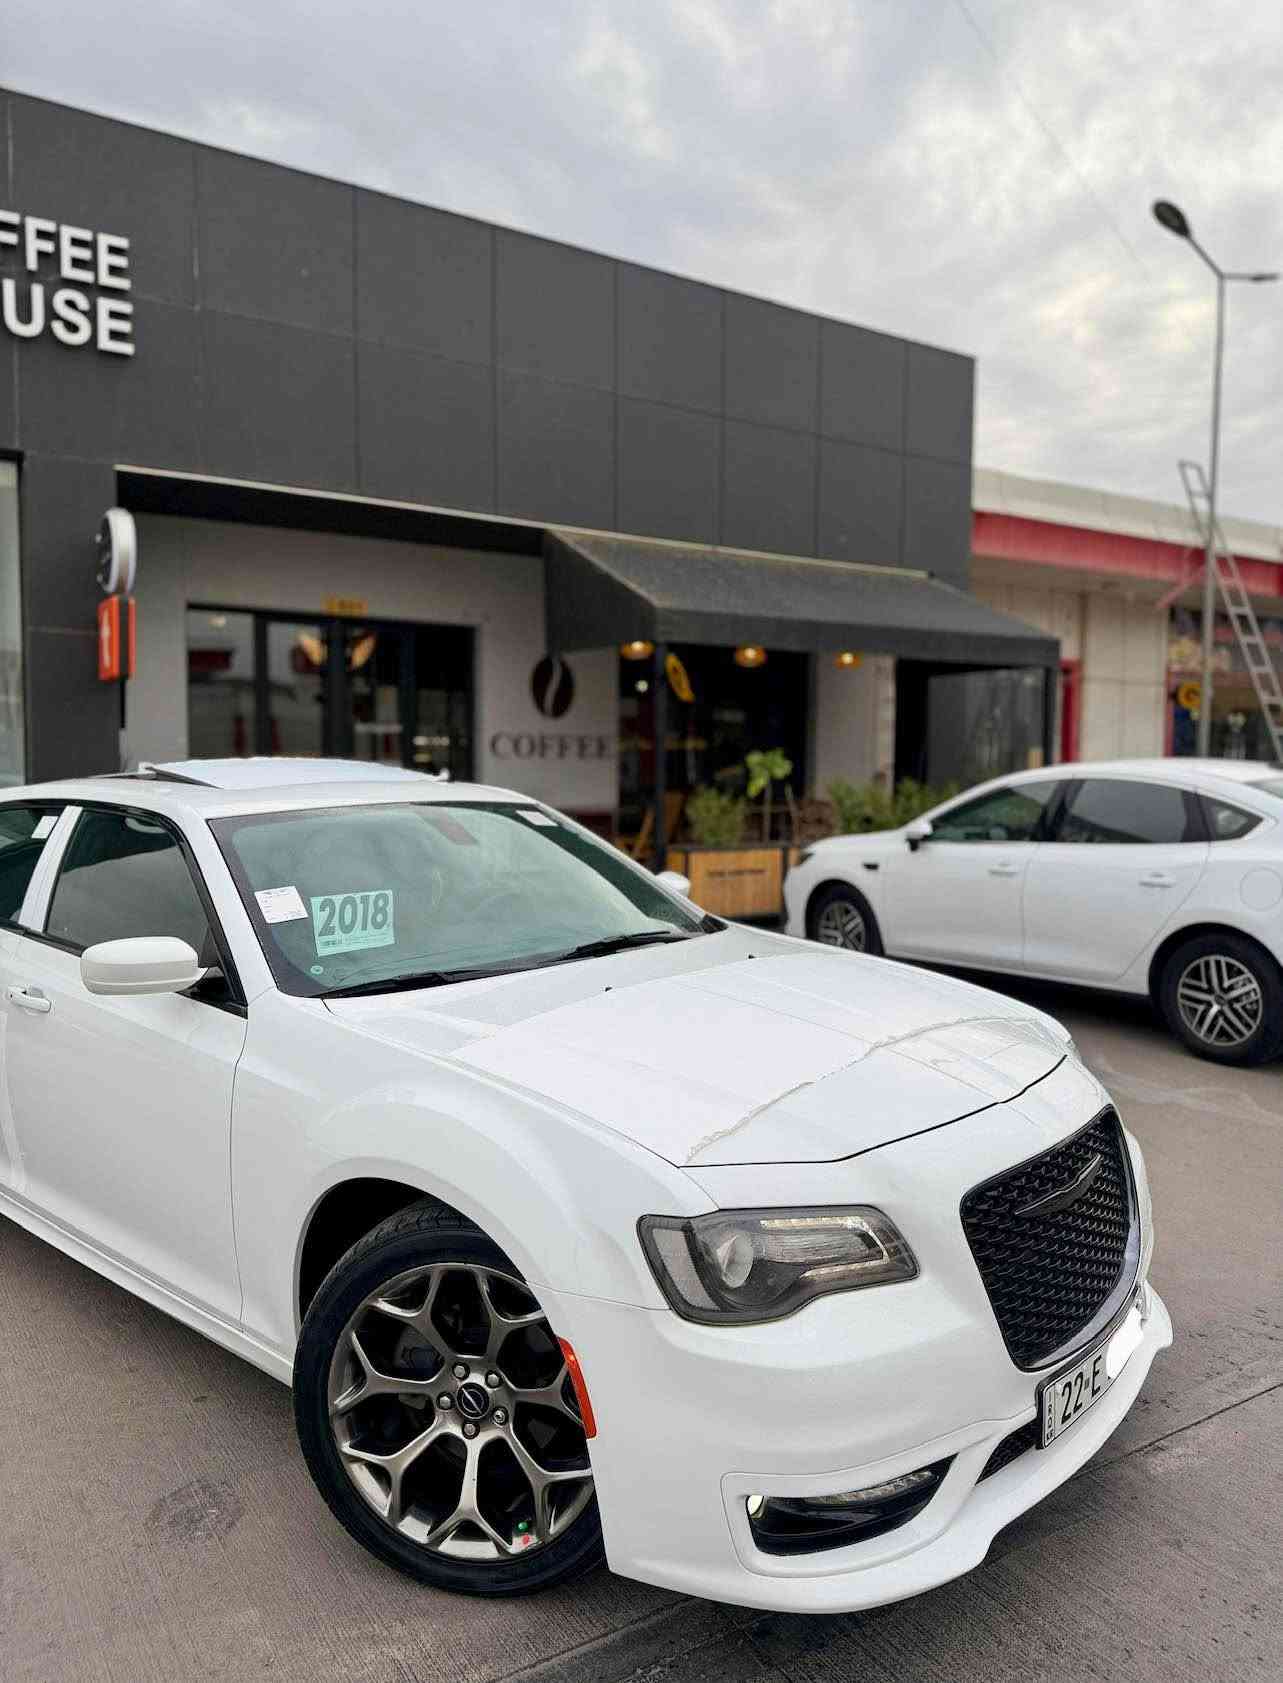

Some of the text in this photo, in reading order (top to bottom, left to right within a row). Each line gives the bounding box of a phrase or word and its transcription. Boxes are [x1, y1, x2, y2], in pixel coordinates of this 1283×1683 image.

[3, 278, 135, 356] USE
[489, 731, 613, 760] COFFEE
[318, 892, 390, 937] 2018
